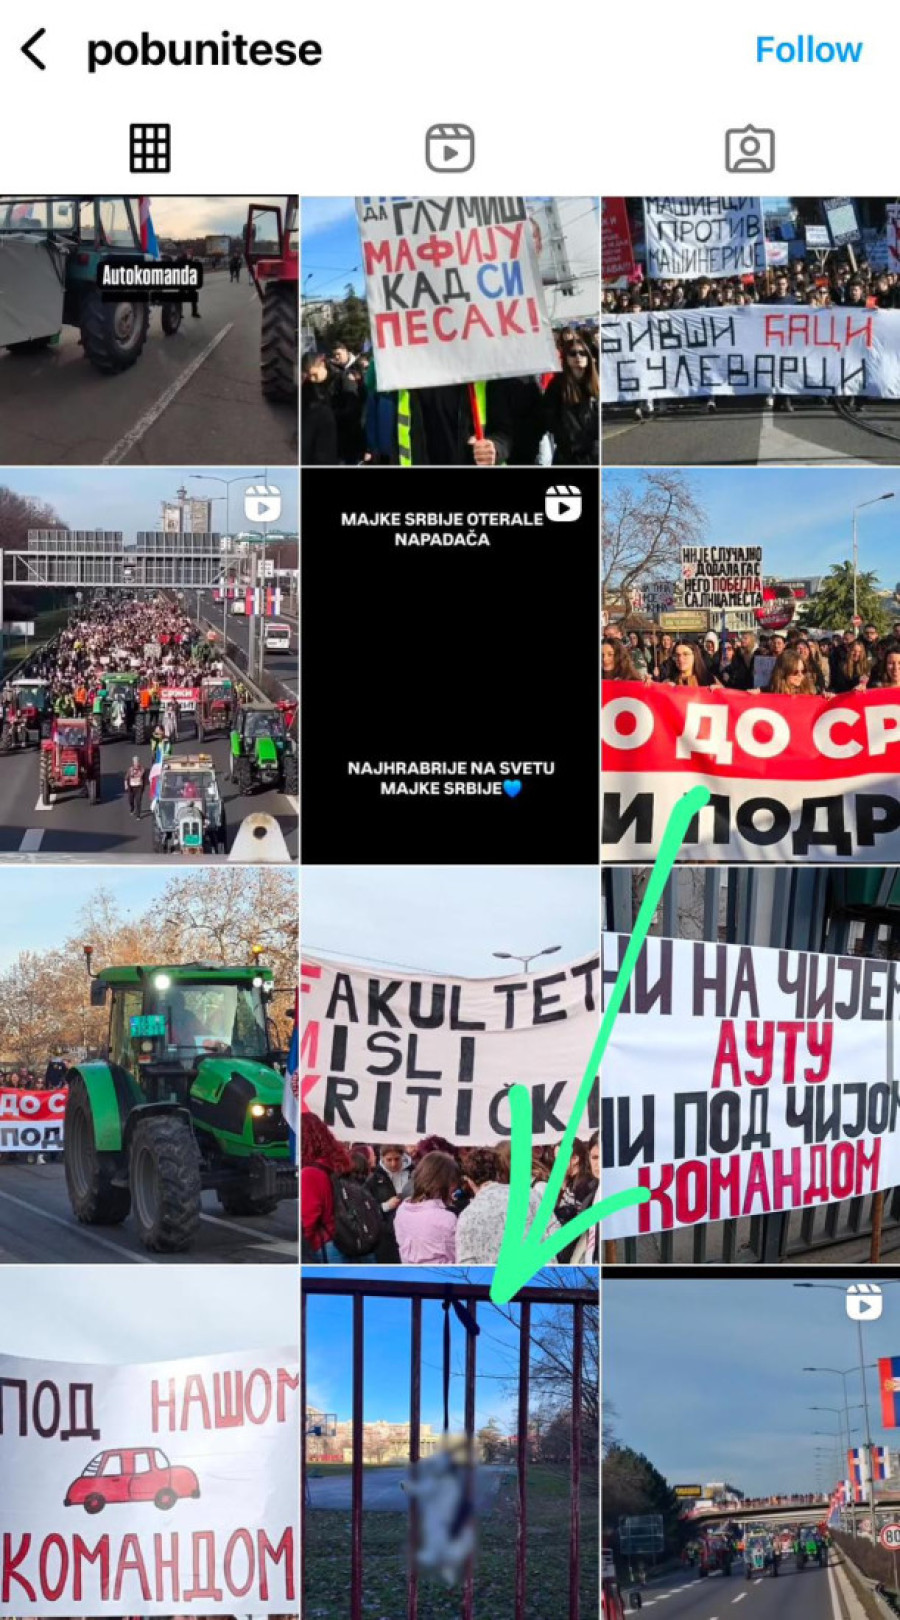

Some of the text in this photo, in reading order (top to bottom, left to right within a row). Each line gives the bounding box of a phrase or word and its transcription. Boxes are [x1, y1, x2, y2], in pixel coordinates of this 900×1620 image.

[87, 32, 323, 73] pobunitese
[756, 35, 863, 64] Follow
[363, 196, 527, 235] ДА ГЛУМИШ
[657, 215, 761, 243] ПРОТИВ
[363, 222, 523, 275] МАФИЈУ
[648, 242, 766, 274] МАШИНЕРИЈЕ
[382, 261, 525, 311] КАД СИ
[374, 297, 541, 348] ПЕСАК!
[601, 316, 736, 353] БИВШИ
[617, 354, 867, 395] БУЛЕВАРЦИ
[684, 578, 710, 592] НЕГО
[676, 702, 791, 765] ДО
[601, 792, 655, 845] И
[692, 942, 760, 1018] НА
[711, 1019, 834, 1088] АУТУ
[0, 1093, 66, 1116] ДО С
[674, 1087, 771, 1160] ПОД
[1, 1127, 64, 1149] ПОД
[638, 1137, 882, 1233] КОМАНДОМ
[0, 1376, 101, 1441] ПОД
[2, 1526, 296, 1602] КОМАНДОМ
